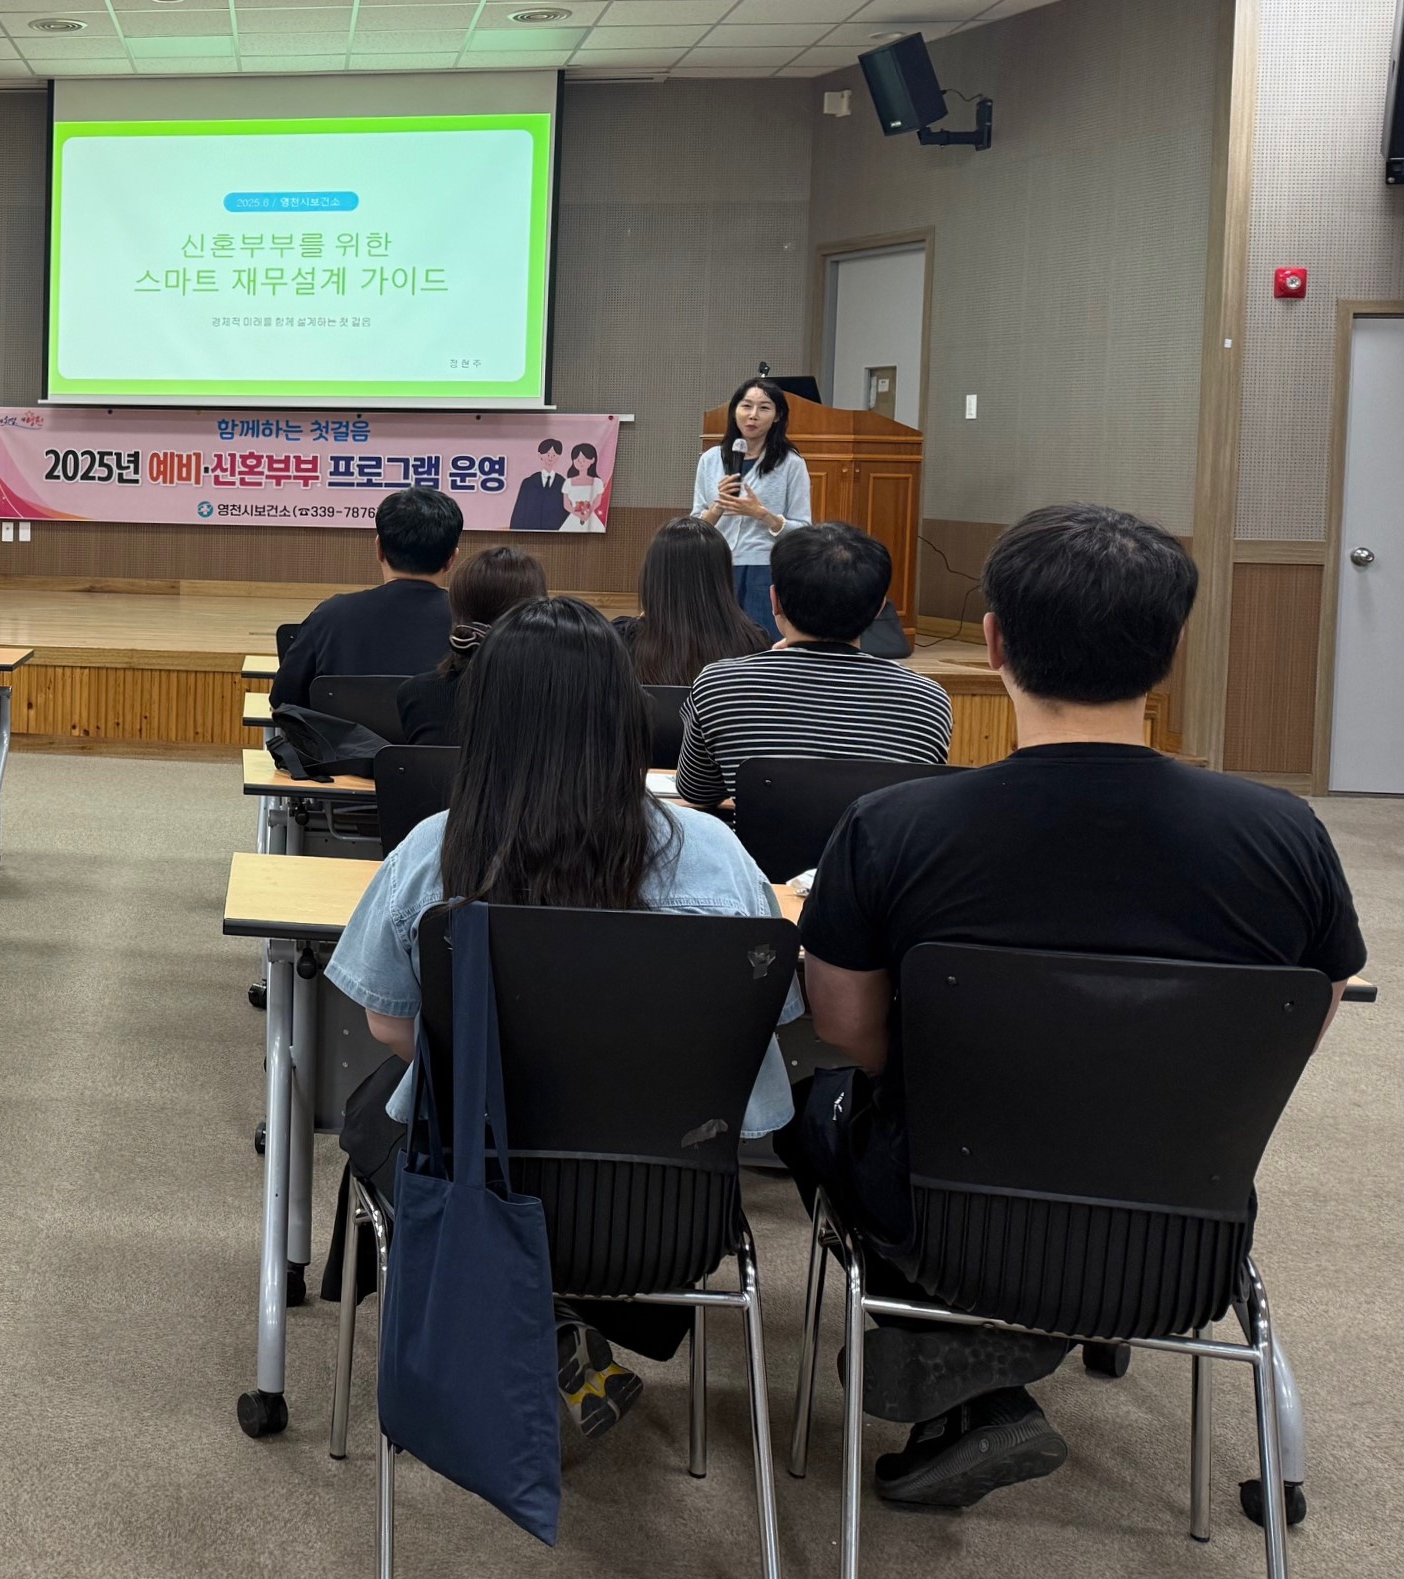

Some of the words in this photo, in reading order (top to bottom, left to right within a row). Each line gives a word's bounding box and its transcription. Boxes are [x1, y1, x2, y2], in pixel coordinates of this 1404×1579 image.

[280, 197, 341, 208] 영천시보건소
[181, 233, 325, 258] 신혼부부를
[335, 232, 392, 257] 위한
[134, 267, 219, 297] 스마트
[232, 266, 346, 297] 재무설계
[361, 266, 449, 296] 가이드
[243, 317, 272, 327] 미래를
[297, 316, 337, 327] 설계하는
[217, 418, 303, 442] 함께하는
[310, 420, 371, 442] 첫걸음
[44, 449, 140, 485] 2025년
[148, 451, 320, 489] 예비·신혼부부
[327, 454, 441, 491] 프로그램
[449, 455, 507, 492] 운영
